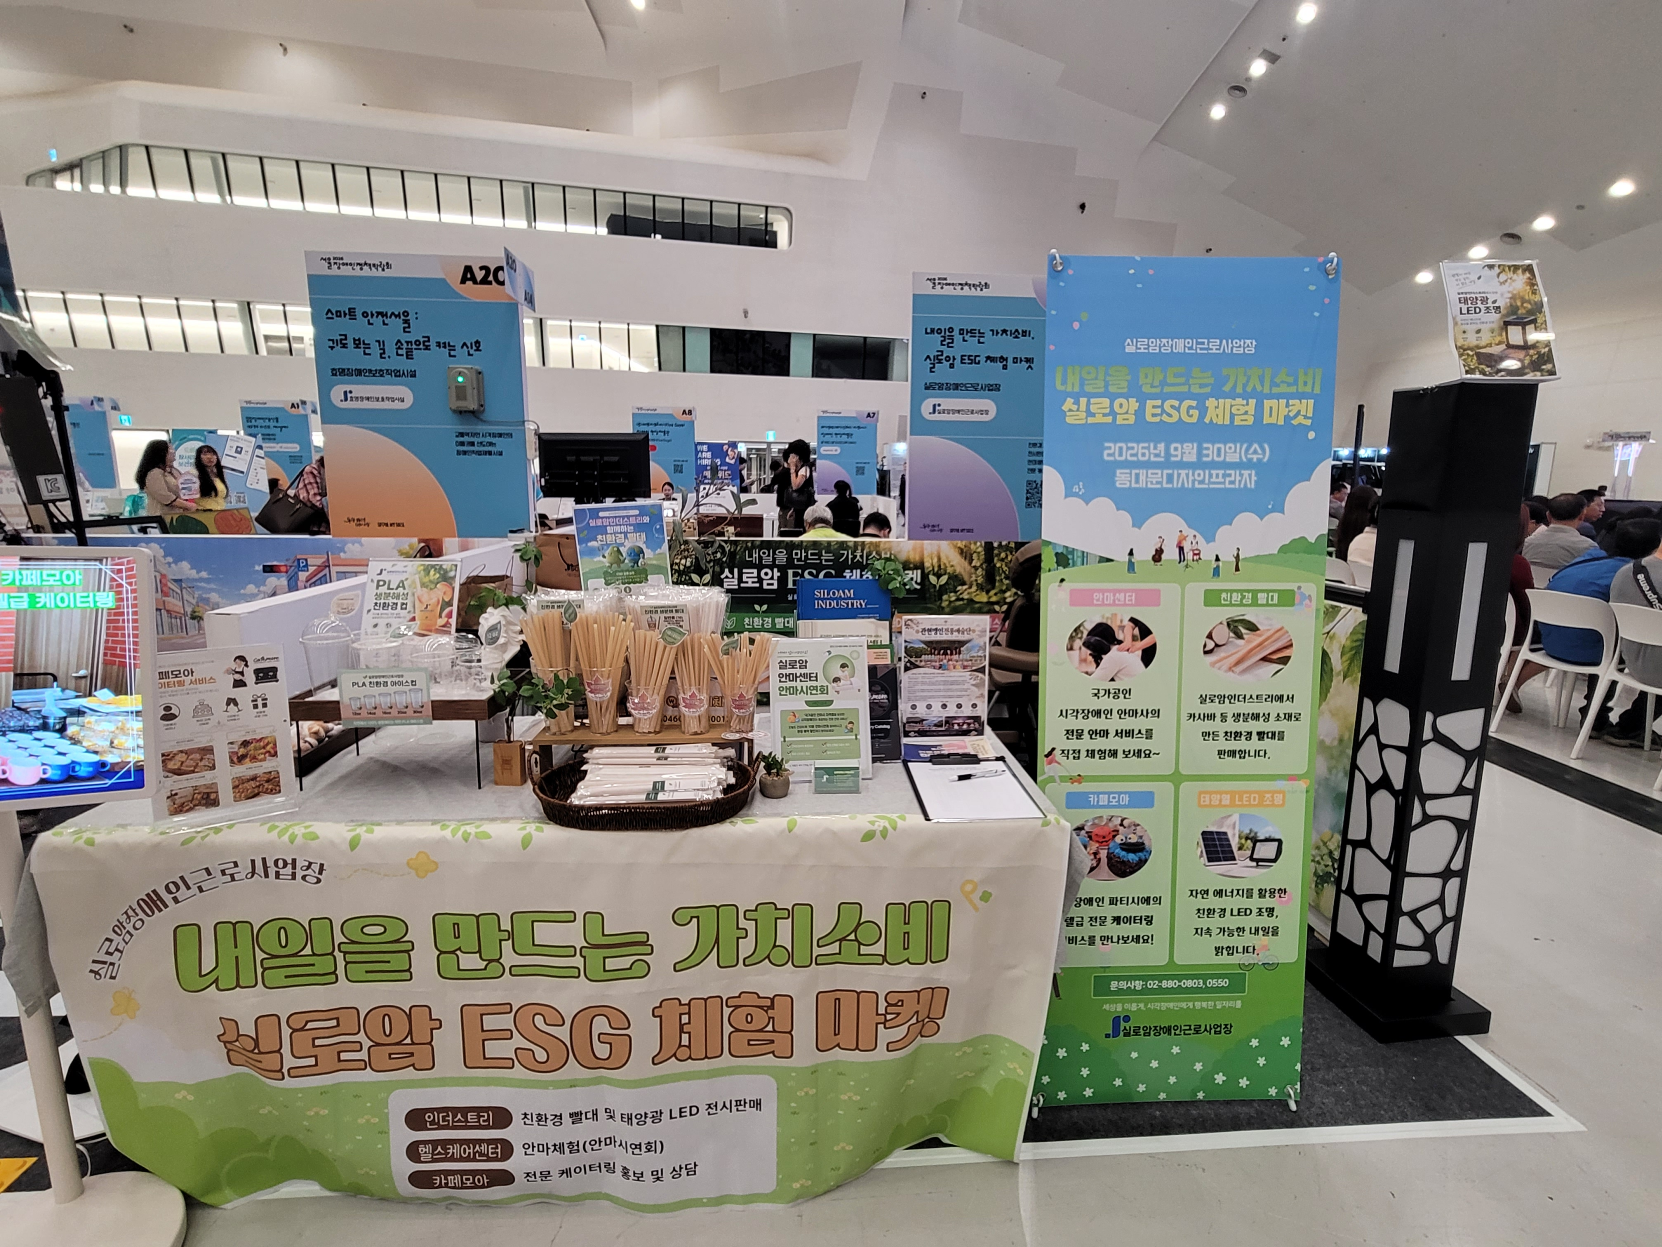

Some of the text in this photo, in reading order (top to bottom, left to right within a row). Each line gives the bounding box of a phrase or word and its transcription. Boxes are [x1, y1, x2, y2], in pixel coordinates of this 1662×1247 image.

[1458, 296, 1489, 305] 태양광
[325, 307, 357, 320] 스마트
[1459, 305, 1502, 315] LED 조명
[925, 326, 954, 348] 내일을
[958, 328, 985, 345] 만드는
[328, 334, 348, 351] 귀로
[353, 337, 371, 356] 보는
[394, 336, 431, 360] 손끝으로
[436, 340, 456, 358] 켜는
[461, 339, 482, 356] 신호
[1124, 338, 1257, 354] 실로암장애인근로사업장
[924, 350, 1034, 373] 실로암 ESG 체험 마켓
[330, 368, 417, 379] 효명장애인보호작업시설
[1055, 365, 1322, 394] 내일을 만드는 가치소비
[924, 382, 1001, 392] 실로암장애인근로사업장
[1061, 397, 1314, 426] 실로암 ESG 체험 마켓
[1103, 442, 1270, 463] 2026년 9월 30일(수)
[1115, 469, 1257, 489] 동대문디자인프라자
[589, 516, 650, 527] 실로암인더스트리와
[606, 525, 634, 534] 함께하는
[596, 532, 646, 545] 친환경 빨대
[745, 549, 788, 566] 내일을
[792, 549, 835, 565] 만드는
[1, 569, 82, 586] 카페모아
[720, 568, 780, 590] 실로암
[376, 579, 406, 590] PLA
[374, 592, 408, 601] 생분해성
[814, 589, 854, 598] SILOAM
[1093, 592, 1136, 605] 안마센터
[1220, 592, 1278, 605] 친환경 빨대
[36, 592, 115, 608] 케이터링
[373, 602, 408, 610] 친환경 컵
[814, 599, 867, 609] INDUSTRY
[743, 617, 794, 629] 친환경 빨대
[777, 659, 808, 670] 실로암
[189, 676, 217, 686] 서비스
[777, 672, 819, 683] 안마센터
[778, 684, 829, 696] 안마시연회
[1090, 688, 1132, 700] 국가공인
[1198, 693, 1295, 705] 실로암인더스트리에서
[1058, 708, 1161, 720] 시각장애인 안마사의
[1186, 712, 1302, 723] 카사바 등 생분해성 소재로
[1064, 728, 1154, 740] 전문 안마 서비스를
[1201, 731, 1285, 742] 만든 친환경 빨대를
[1059, 748, 1161, 761] 직접 체험해 보세요~
[1217, 749, 1271, 760] 판매합니다.
[1088, 794, 1130, 805] 카페모아
[1200, 793, 1283, 805] 태양열 LED 조명
[1188, 887, 1287, 899] 자연 에너지를 활용한
[1108, 896, 1162, 907] 파티시에의
[88, 856, 327, 981] 실로암장애인근로사업장
[1195, 907, 1279, 919] 친환경 LED 조명,
[1087, 916, 1108, 927] 전문
[1110, 915, 1154, 926] 케이터링
[1193, 926, 1279, 938] 지속 가능한 내일을
[173, 899, 952, 993] 내일을 만드는 가치소비
[1065, 934, 1154, 946] 비스를 만나보세요!
[1214, 945, 1259, 956] 밝힙니다.
[1109, 979, 1229, 991] 문의사항: 02-880-0803, 0550
[1147, 1001, 1193, 1010] 시각장애인에게
[1216, 1000, 1242, 1009] 일자리를
[217, 986, 950, 1081] 실로암 ESG 체험 마켓
[1121, 1023, 1233, 1037] 실로암장애인근로사업장
[520, 1097, 763, 1128] 친환경 빨대 및 태양광 LED 전시판매
[424, 1111, 493, 1128] 인더스트리
[417, 1142, 502, 1161] 헬스케어센터
[521, 1135, 664, 1158] 안마체험(안마시연회)
[523, 1160, 699, 1184] 전문 케이터링 홍보 및 상담
[432, 1174, 489, 1188] 카페모아
